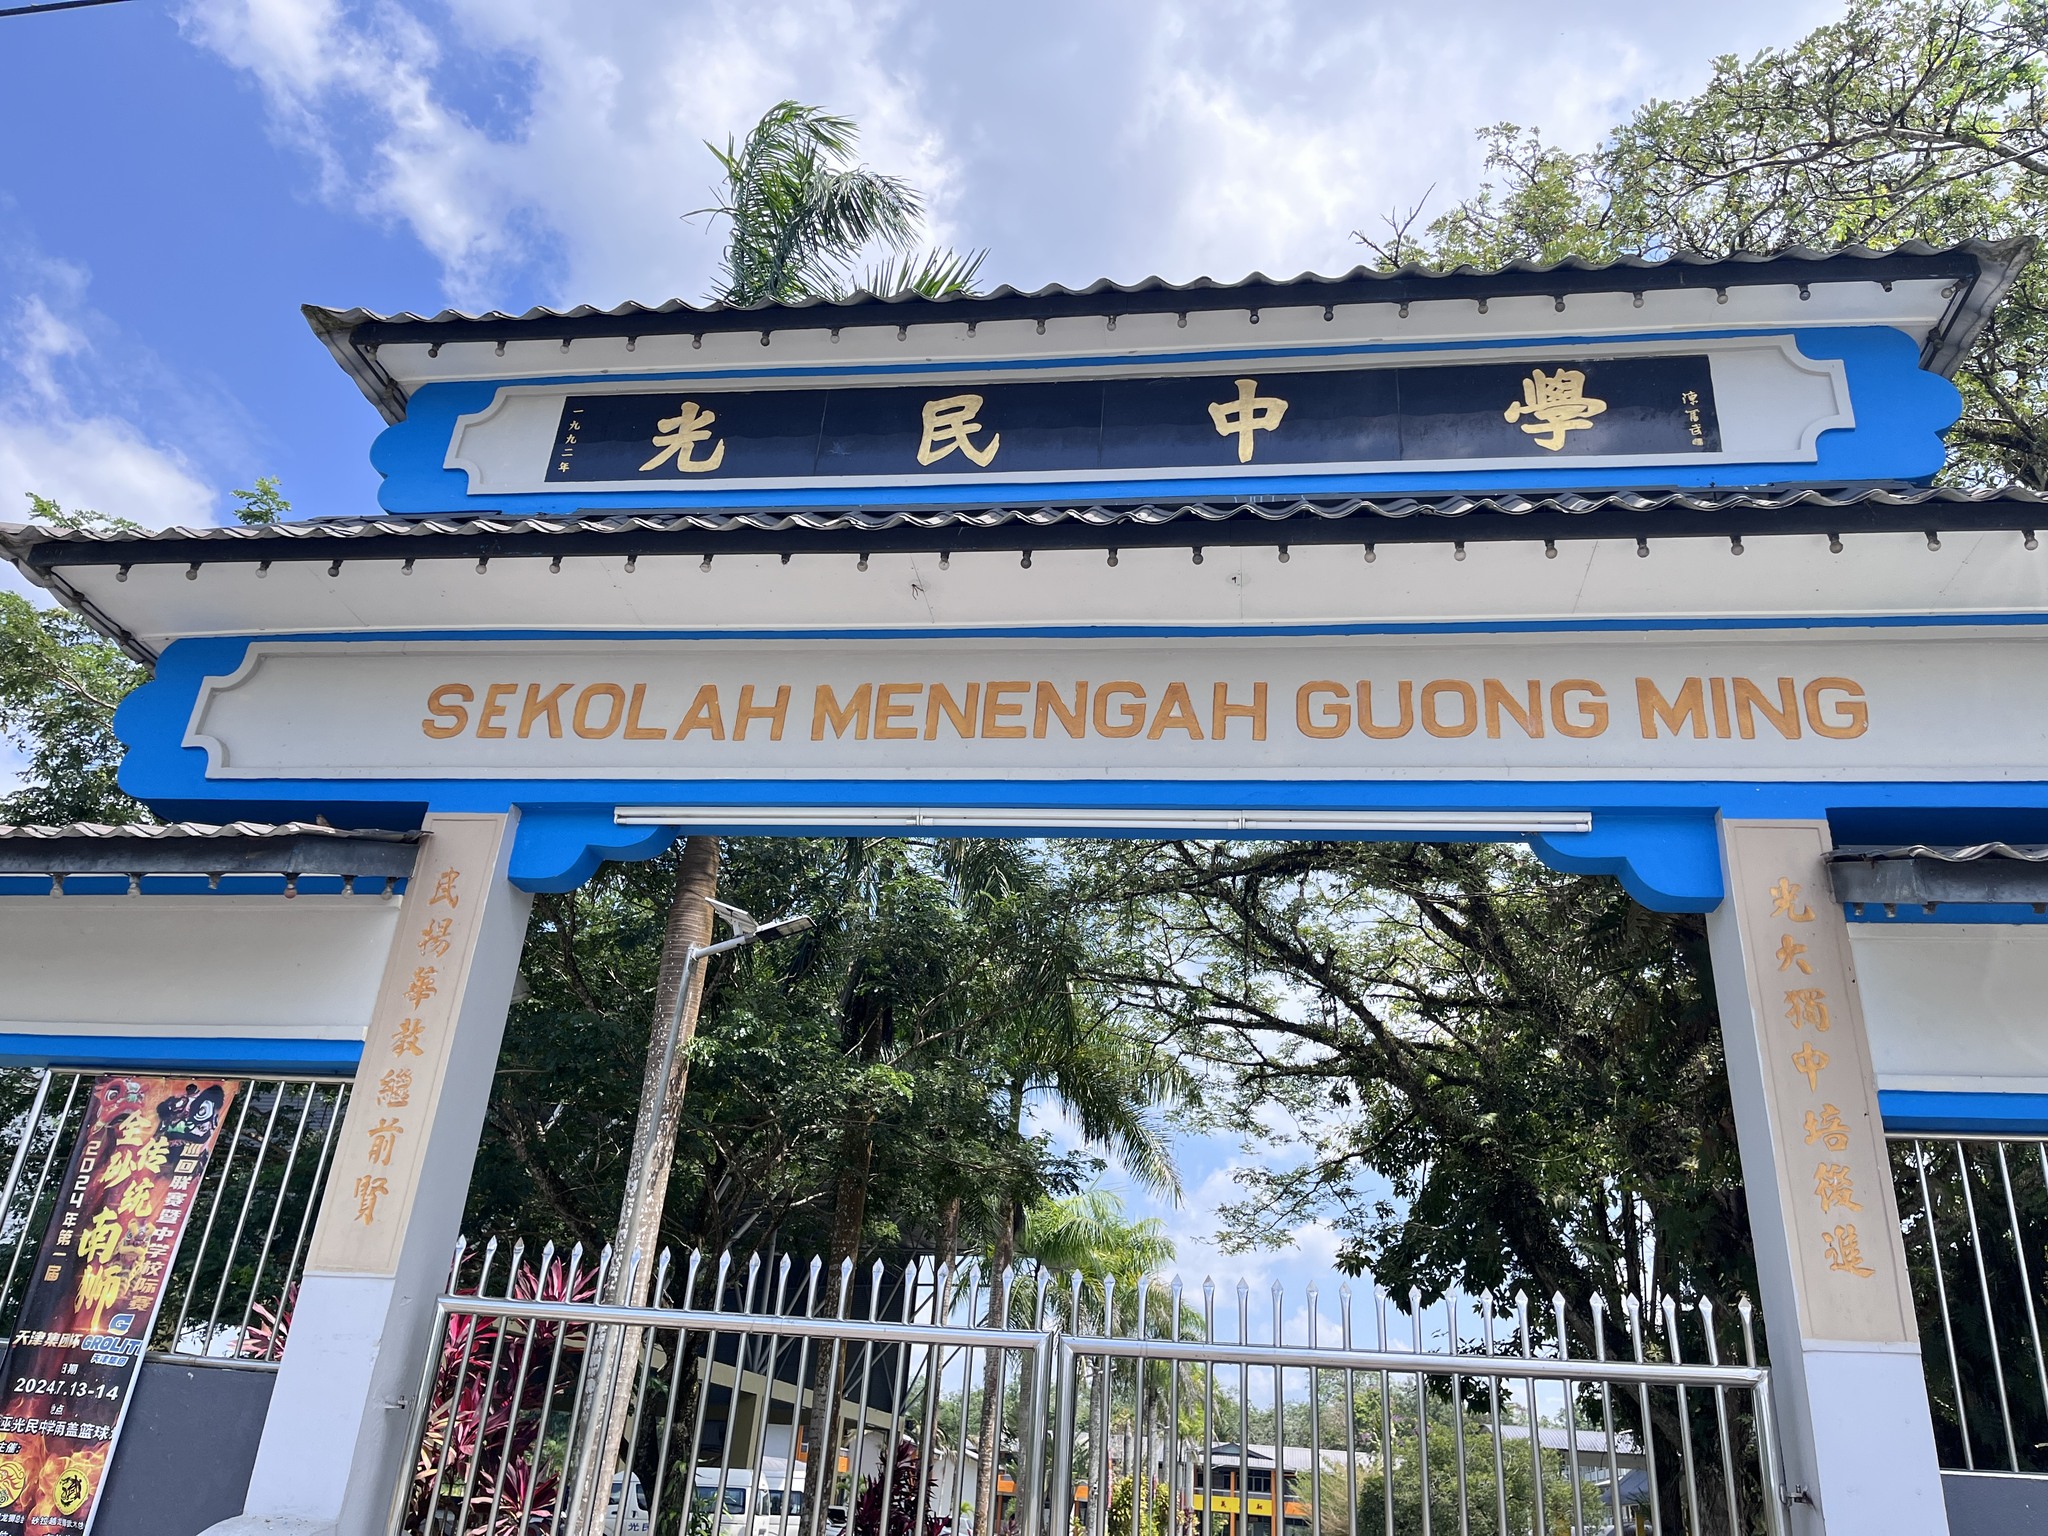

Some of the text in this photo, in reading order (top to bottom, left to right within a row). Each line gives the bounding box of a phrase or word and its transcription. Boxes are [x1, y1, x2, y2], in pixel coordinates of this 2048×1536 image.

[557, 408, 585, 473] 一九九二年
[422, 676, 1869, 742] SEKOLAH MENENGAH GUONG MING
